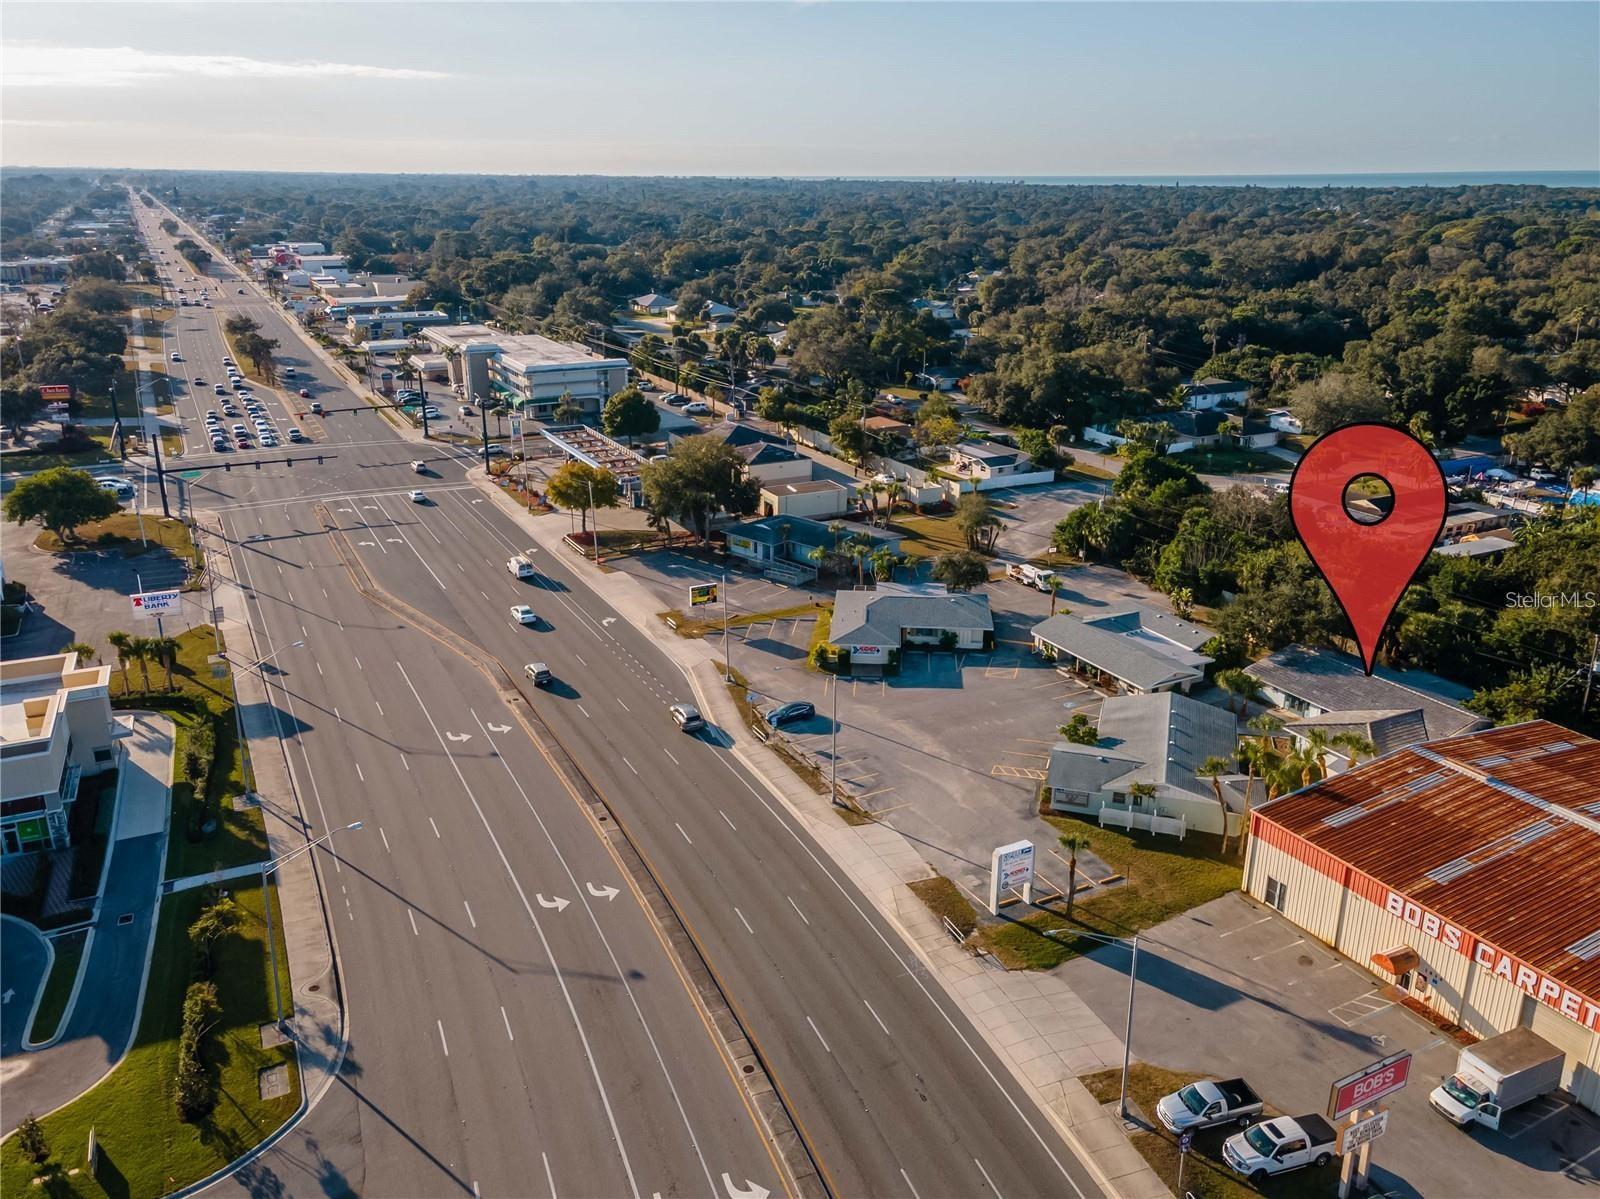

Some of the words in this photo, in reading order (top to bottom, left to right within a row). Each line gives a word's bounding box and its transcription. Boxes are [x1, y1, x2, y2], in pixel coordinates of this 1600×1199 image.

[143, 593, 178, 602] LIBERTY
[1474, 942, 1600, 1028] CARPET
[1353, 1068, 1395, 1099] BOB'S
